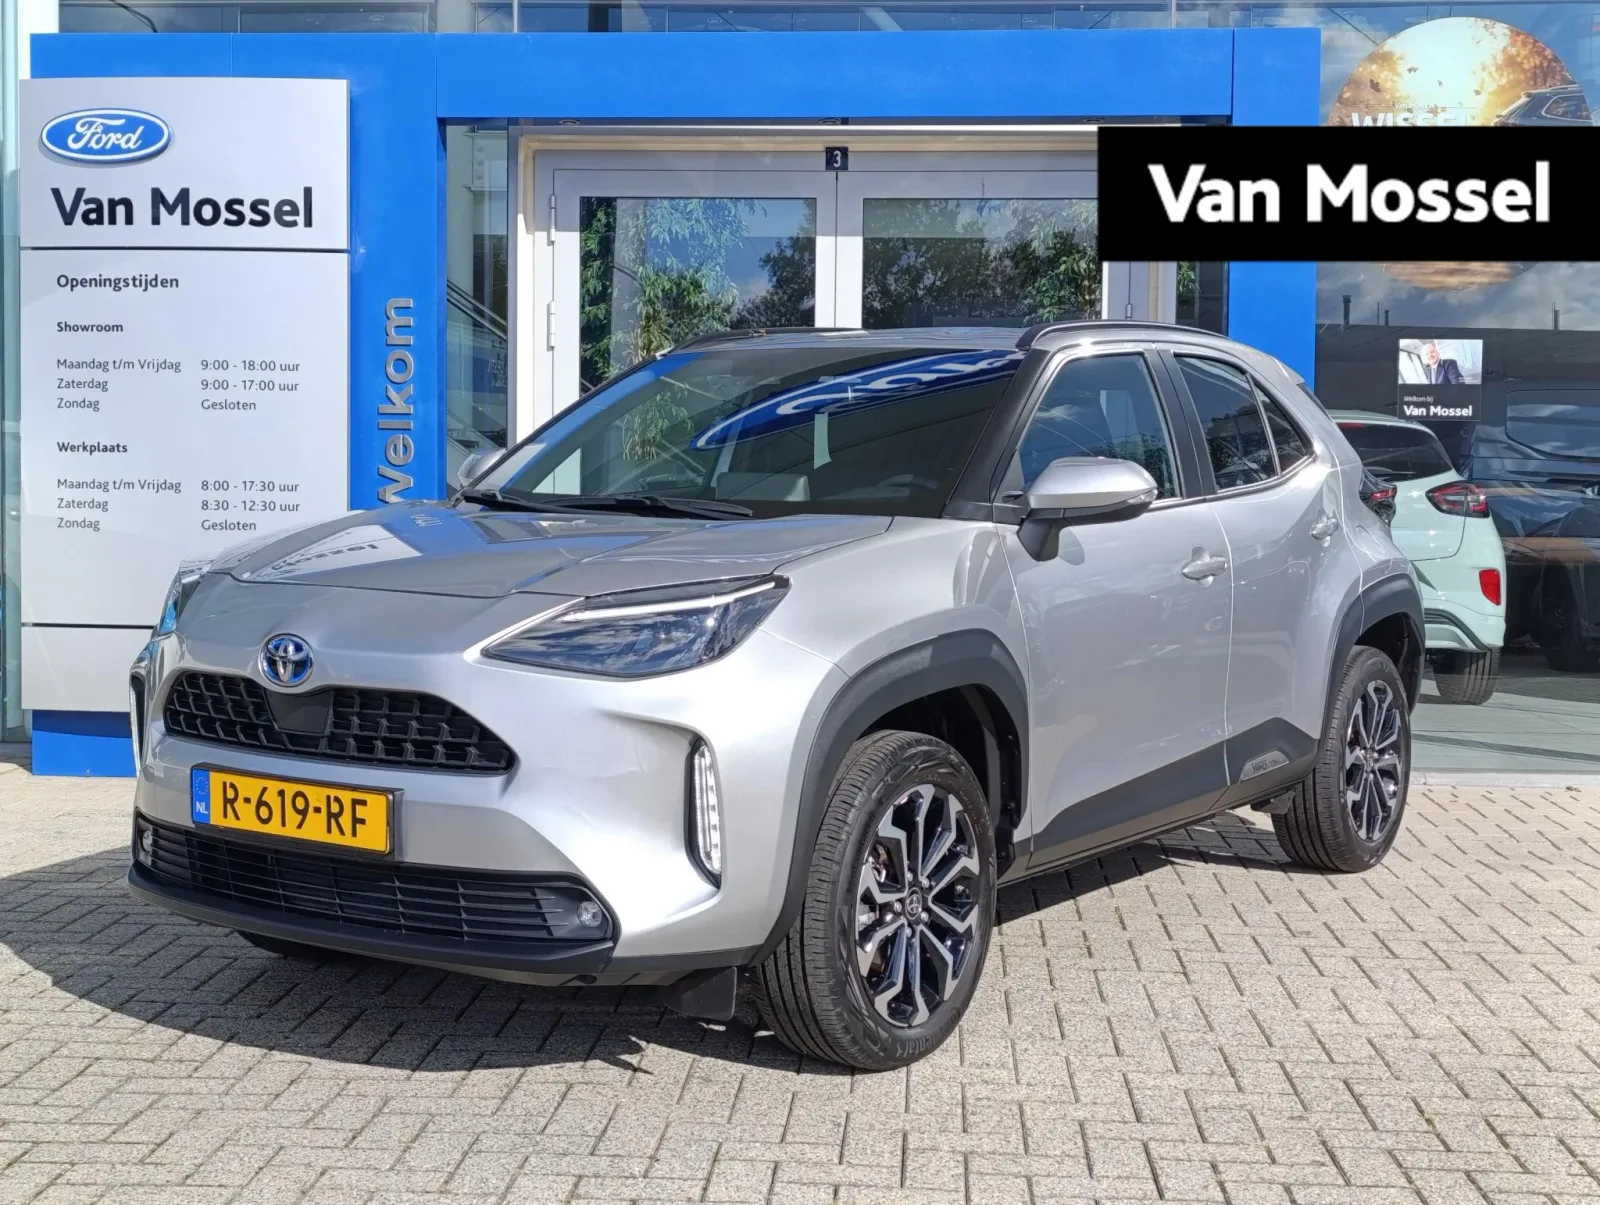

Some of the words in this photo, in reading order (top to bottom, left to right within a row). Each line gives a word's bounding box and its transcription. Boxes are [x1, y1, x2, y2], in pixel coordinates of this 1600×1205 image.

[67, 117, 145, 150] Ford
[832, 149, 842, 168] 3
[50, 186, 134, 227] Van
[150, 186, 313, 229] Mossel
[56, 273, 180, 292] Openingstijden
[56, 320, 124, 333] Showroom
[56, 357, 110, 373] Maandag
[112, 357, 135, 370] t/m
[138, 358, 182, 374] Vrijdag
[200, 359, 229, 371] 9:00
[241, 359, 277, 371] 18:00
[279, 362, 301, 372] uur
[56, 377, 109, 393] Zaterdag
[200, 379, 229, 391] 9:00
[241, 379, 277, 391] 17:00
[278, 382, 300, 392] uur
[56, 397, 101, 412] Zondag
[200, 398, 257, 411] Gesloten
[376, 297, 415, 505] Welkom
[1403, 405, 1427, 416] Van
[1429, 404, 1473, 417] Mossel
[56, 440, 128, 456] Werkplaats
[57, 478, 110, 493] Maandag
[112, 478, 135, 491] t/m
[138, 478, 182, 495] Vrijdag
[200, 480, 229, 492] 8:00
[241, 480, 277, 492] 17:30
[278, 483, 300, 493] uur
[57, 497, 109, 513] Zaterdag
[200, 499, 229, 511] 8:30
[241, 499, 277, 511] 12:30
[279, 502, 301, 512] uur
[57, 517, 101, 532] Zondag
[200, 518, 257, 531] Gesloten
[195, 801, 209, 815] NL
[221, 780, 369, 838] R-619-RF
